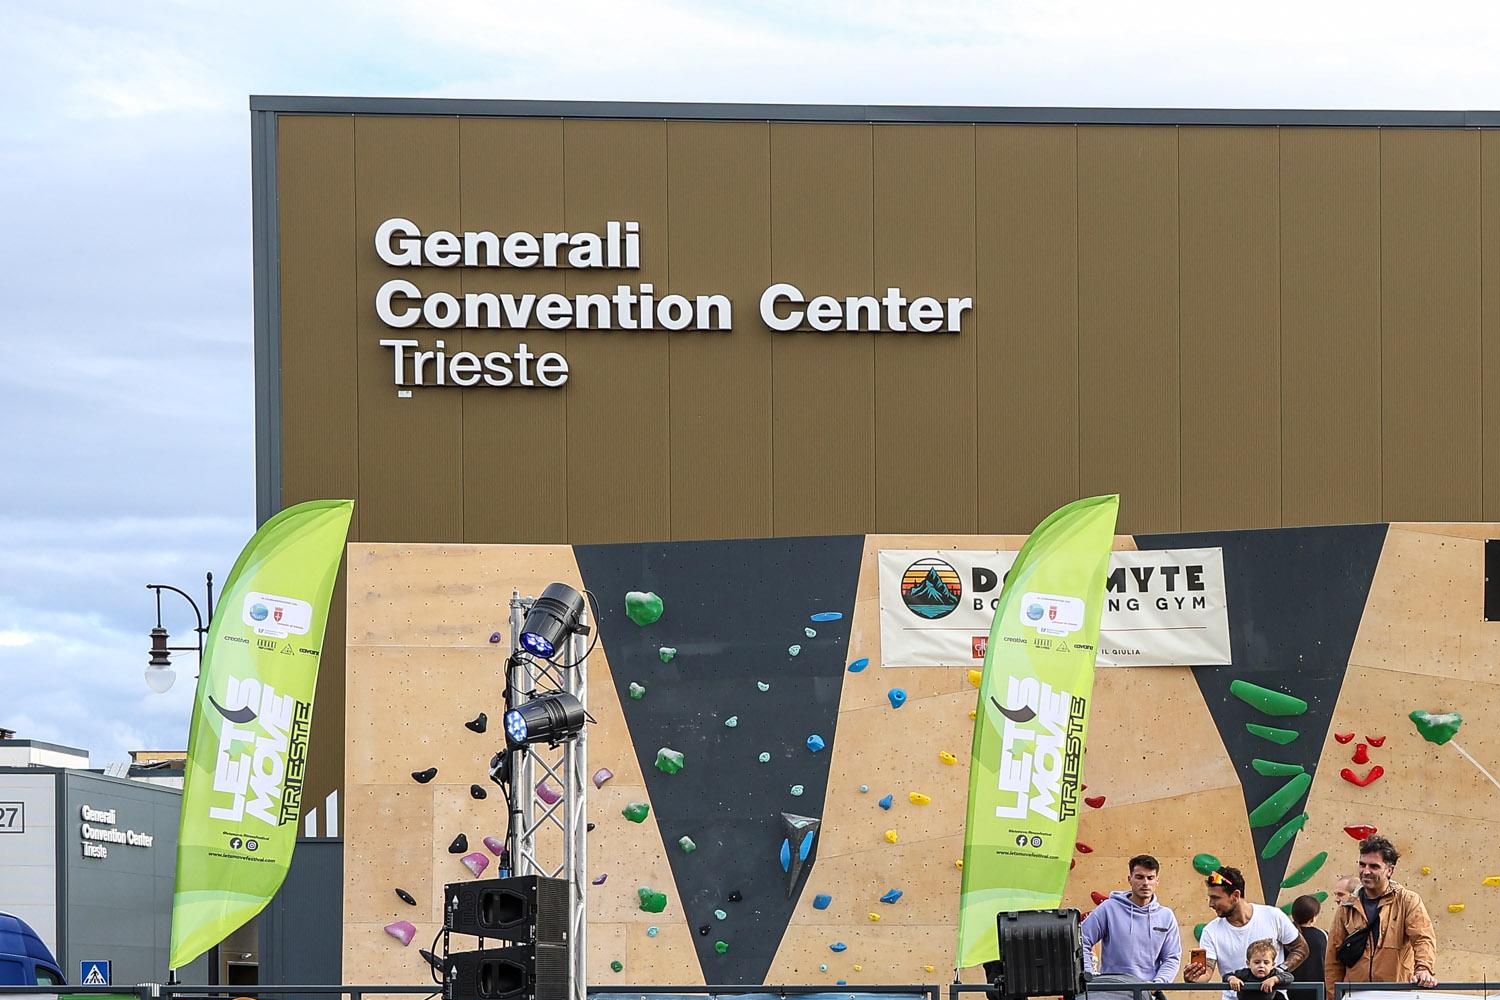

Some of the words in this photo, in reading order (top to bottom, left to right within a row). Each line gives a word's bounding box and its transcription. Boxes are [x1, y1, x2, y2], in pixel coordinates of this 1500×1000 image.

[375, 218, 640, 268] Generali
[376, 279, 732, 330] Convention
[760, 284, 972, 333] Center
[380, 339, 570, 388] Trieste
[1155, 597, 1206, 610] GYM
[246, 683, 295, 827] MOVE
[278, 700, 311, 827] TRIESTE
[1030, 682, 1071, 822] MOVE
[1059, 695, 1086, 822] TRIESTE
[81, 804, 116, 825] Generali
[81, 824, 127, 844] Convention
[127, 830, 153, 847] Center
[82, 841, 107, 858] Trieste
